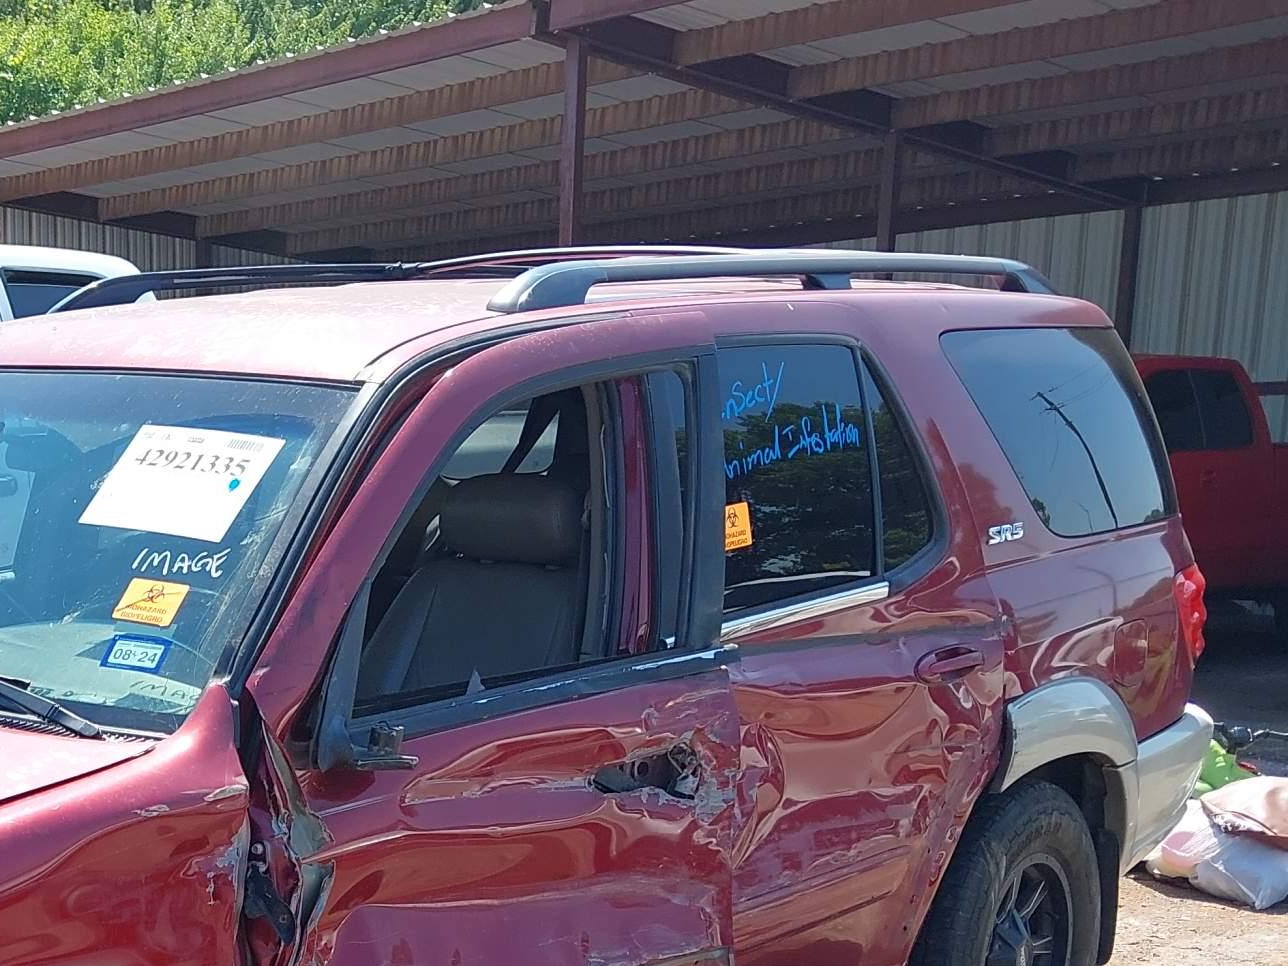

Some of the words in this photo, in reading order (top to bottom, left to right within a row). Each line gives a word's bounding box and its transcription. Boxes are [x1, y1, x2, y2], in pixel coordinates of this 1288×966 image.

[134, 448, 251, 477] 42921335
[988, 521, 1024, 545] SR5
[131, 548, 232, 578] IMAGE
